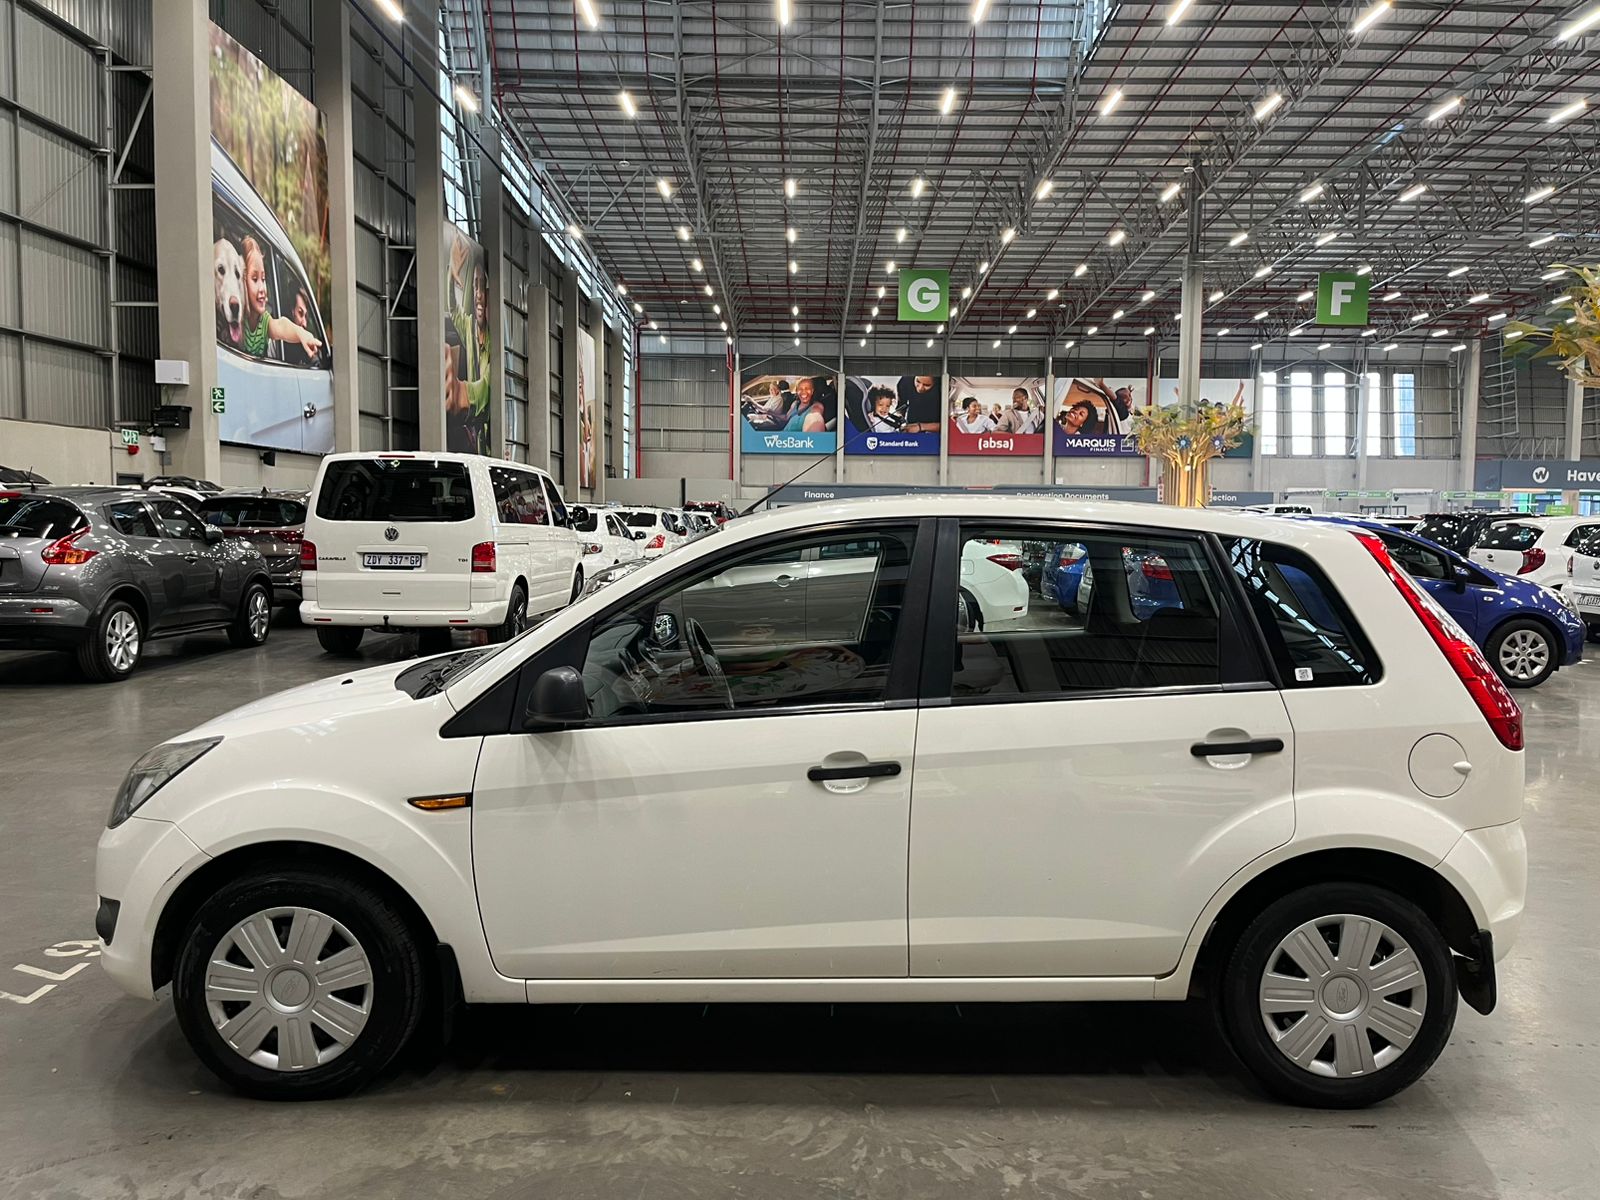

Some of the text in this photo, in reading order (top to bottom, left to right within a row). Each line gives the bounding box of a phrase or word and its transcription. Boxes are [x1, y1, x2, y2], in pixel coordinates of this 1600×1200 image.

[907, 278, 940, 313] G
[1330, 281, 1356, 316] F
[763, 434, 814, 448] WesBank
[1066, 438, 1116, 448] MARQUIS
[804, 490, 835, 499] Finance
[366, 555, 420, 565] ZDY 337 GP
